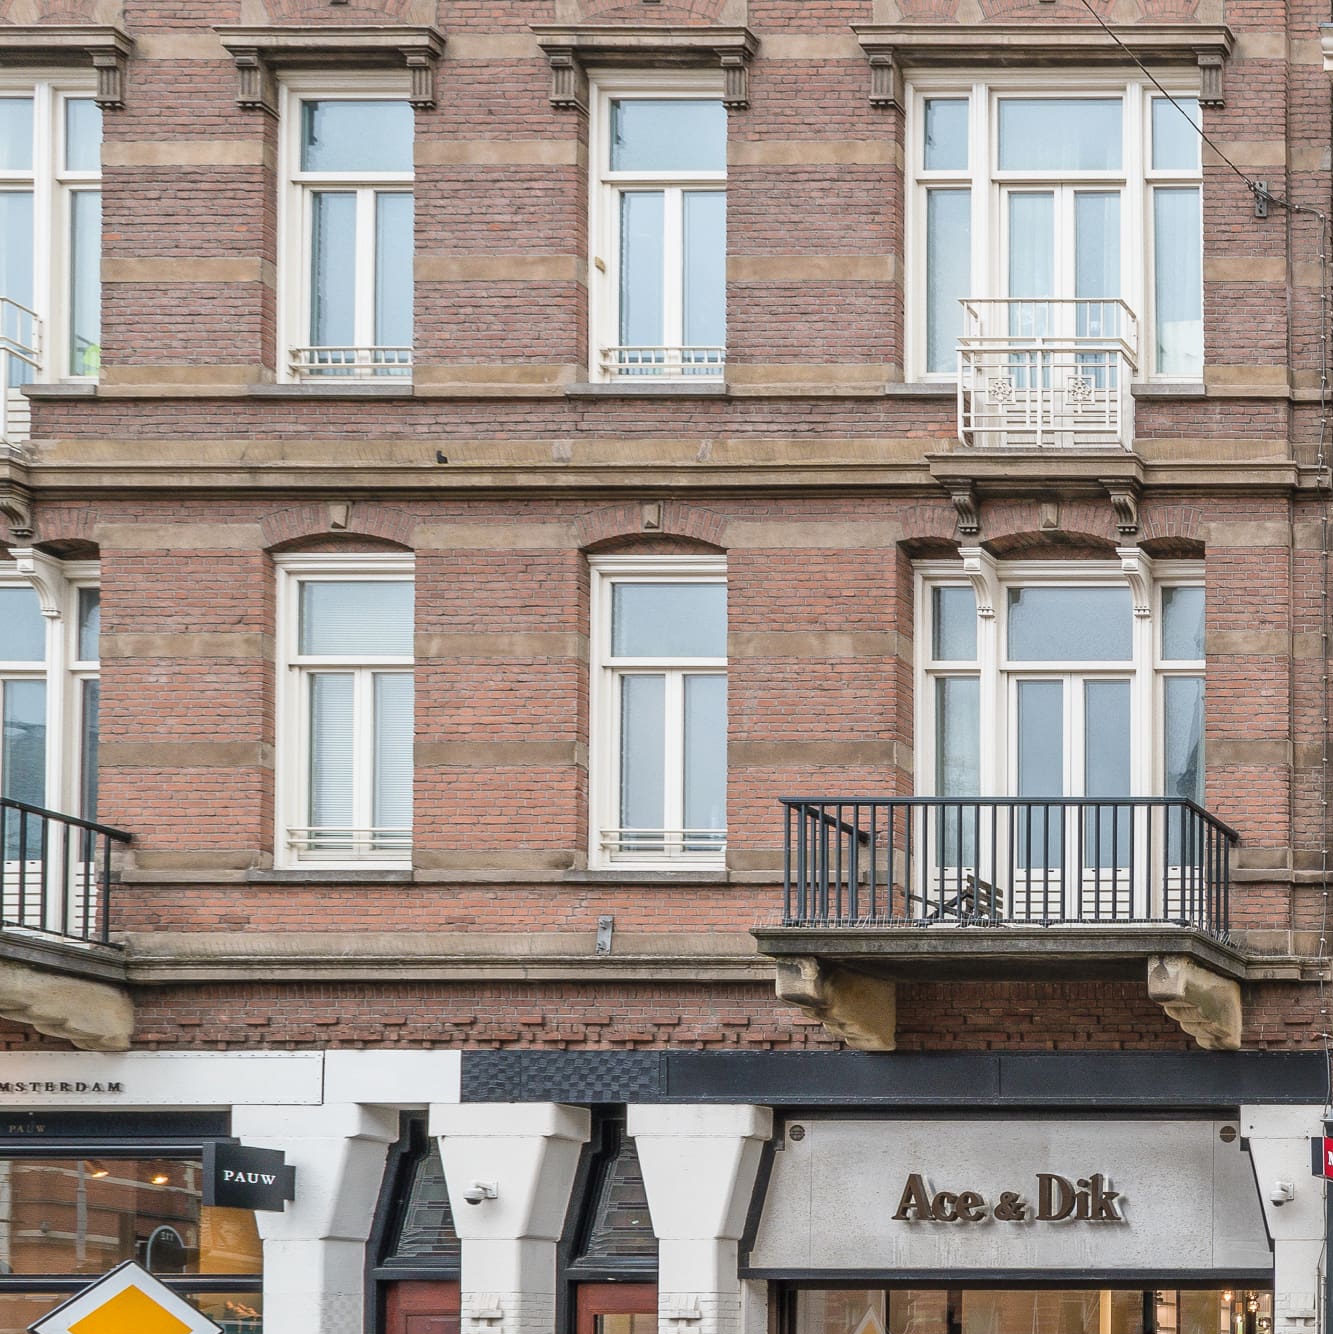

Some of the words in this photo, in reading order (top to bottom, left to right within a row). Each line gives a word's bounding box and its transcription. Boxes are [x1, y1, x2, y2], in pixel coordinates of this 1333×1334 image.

[8, 1124, 46, 1134] PAUW
[223, 1170, 277, 1185] PAUW
[891, 1172, 987, 1222] Ace
[994, 1191, 1026, 1222] &
[1035, 1172, 1122, 1222] Dik
